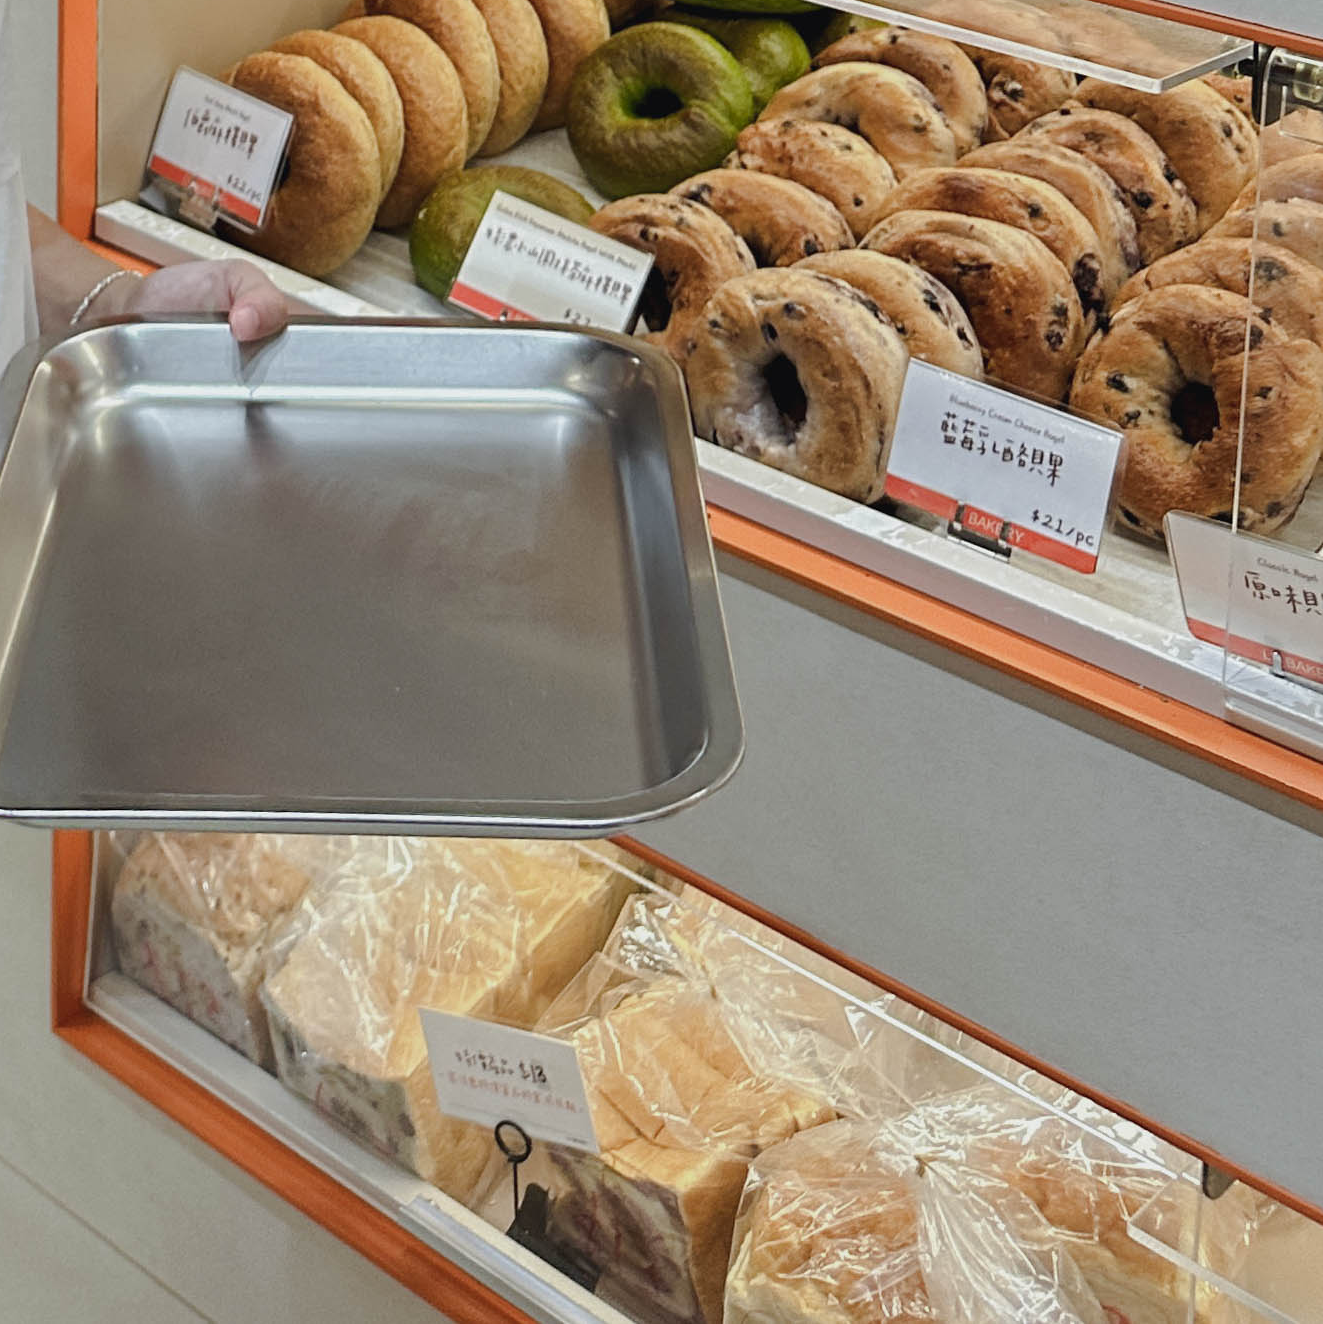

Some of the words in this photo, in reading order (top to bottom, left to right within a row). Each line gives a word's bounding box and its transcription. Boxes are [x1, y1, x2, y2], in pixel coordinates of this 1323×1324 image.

[1030, 509, 1095, 548] $21/pc
[1243, 570, 1323, 617] 原味貝
